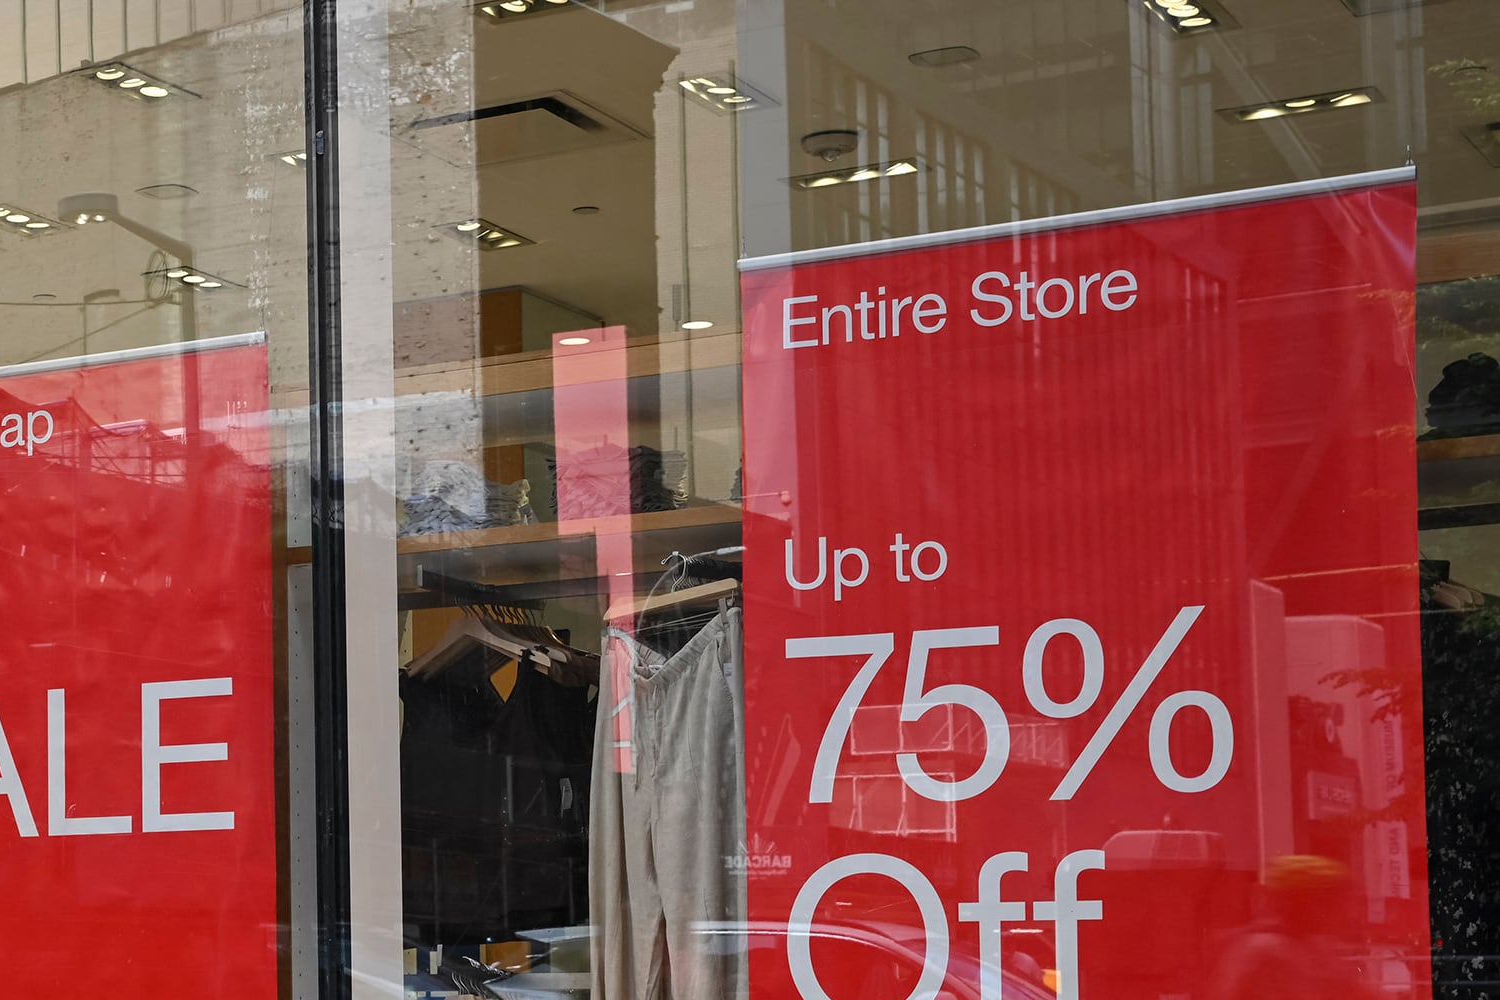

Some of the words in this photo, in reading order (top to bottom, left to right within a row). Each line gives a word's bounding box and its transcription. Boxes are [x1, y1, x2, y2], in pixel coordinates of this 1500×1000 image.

[782, 285, 948, 350] Entire
[969, 269, 1139, 328] Store
[784, 536, 870, 602] Up
[889, 532, 949, 583] to
[784, 604, 1235, 804] 75%
